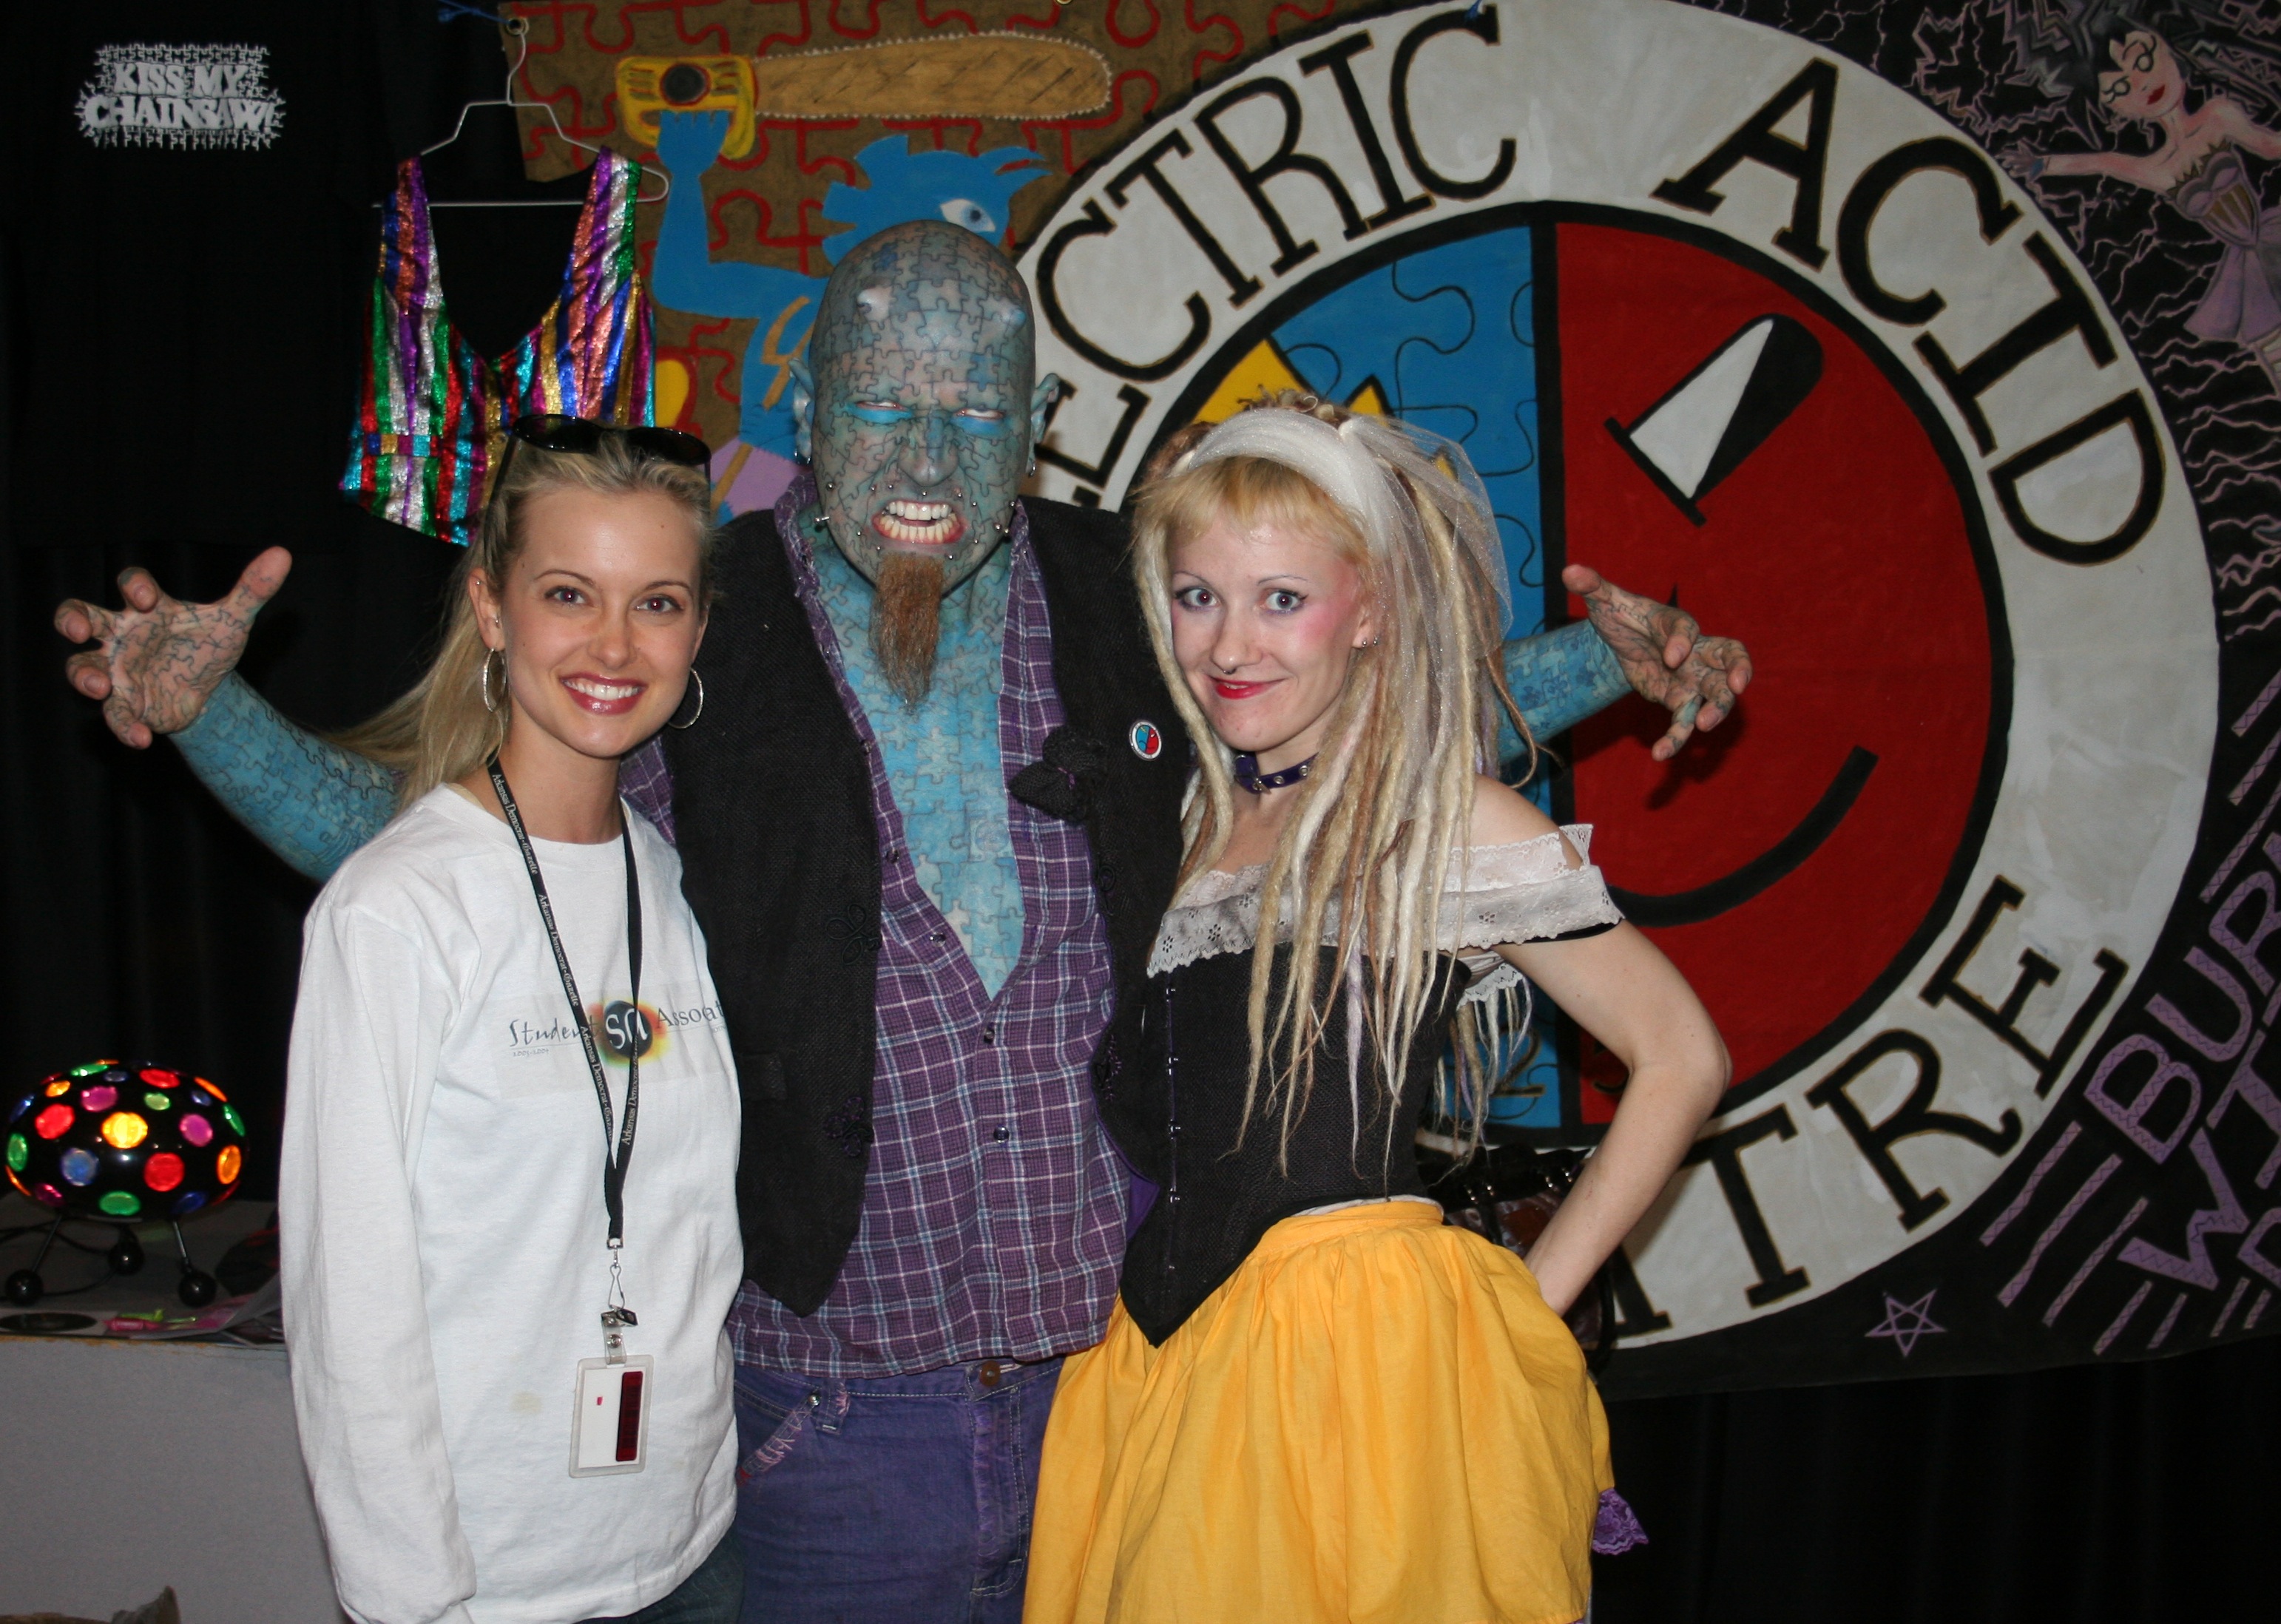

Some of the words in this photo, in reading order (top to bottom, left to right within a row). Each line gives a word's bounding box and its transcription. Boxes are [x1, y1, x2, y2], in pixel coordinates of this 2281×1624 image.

[113, 61, 185, 96] KISS
[192, 64, 249, 98] MY
[1649, 57, 2166, 567] ACID
[492, 774, 510, 805] Arkansas
[538, 893, 555, 930] Arkansas
[2084, 831, 2281, 1164] BUR
[580, 1026, 598, 1063] Arkansas
[1616, 875, 2129, 1329] TRE
[621, 1107, 636, 1146] Arkansas
